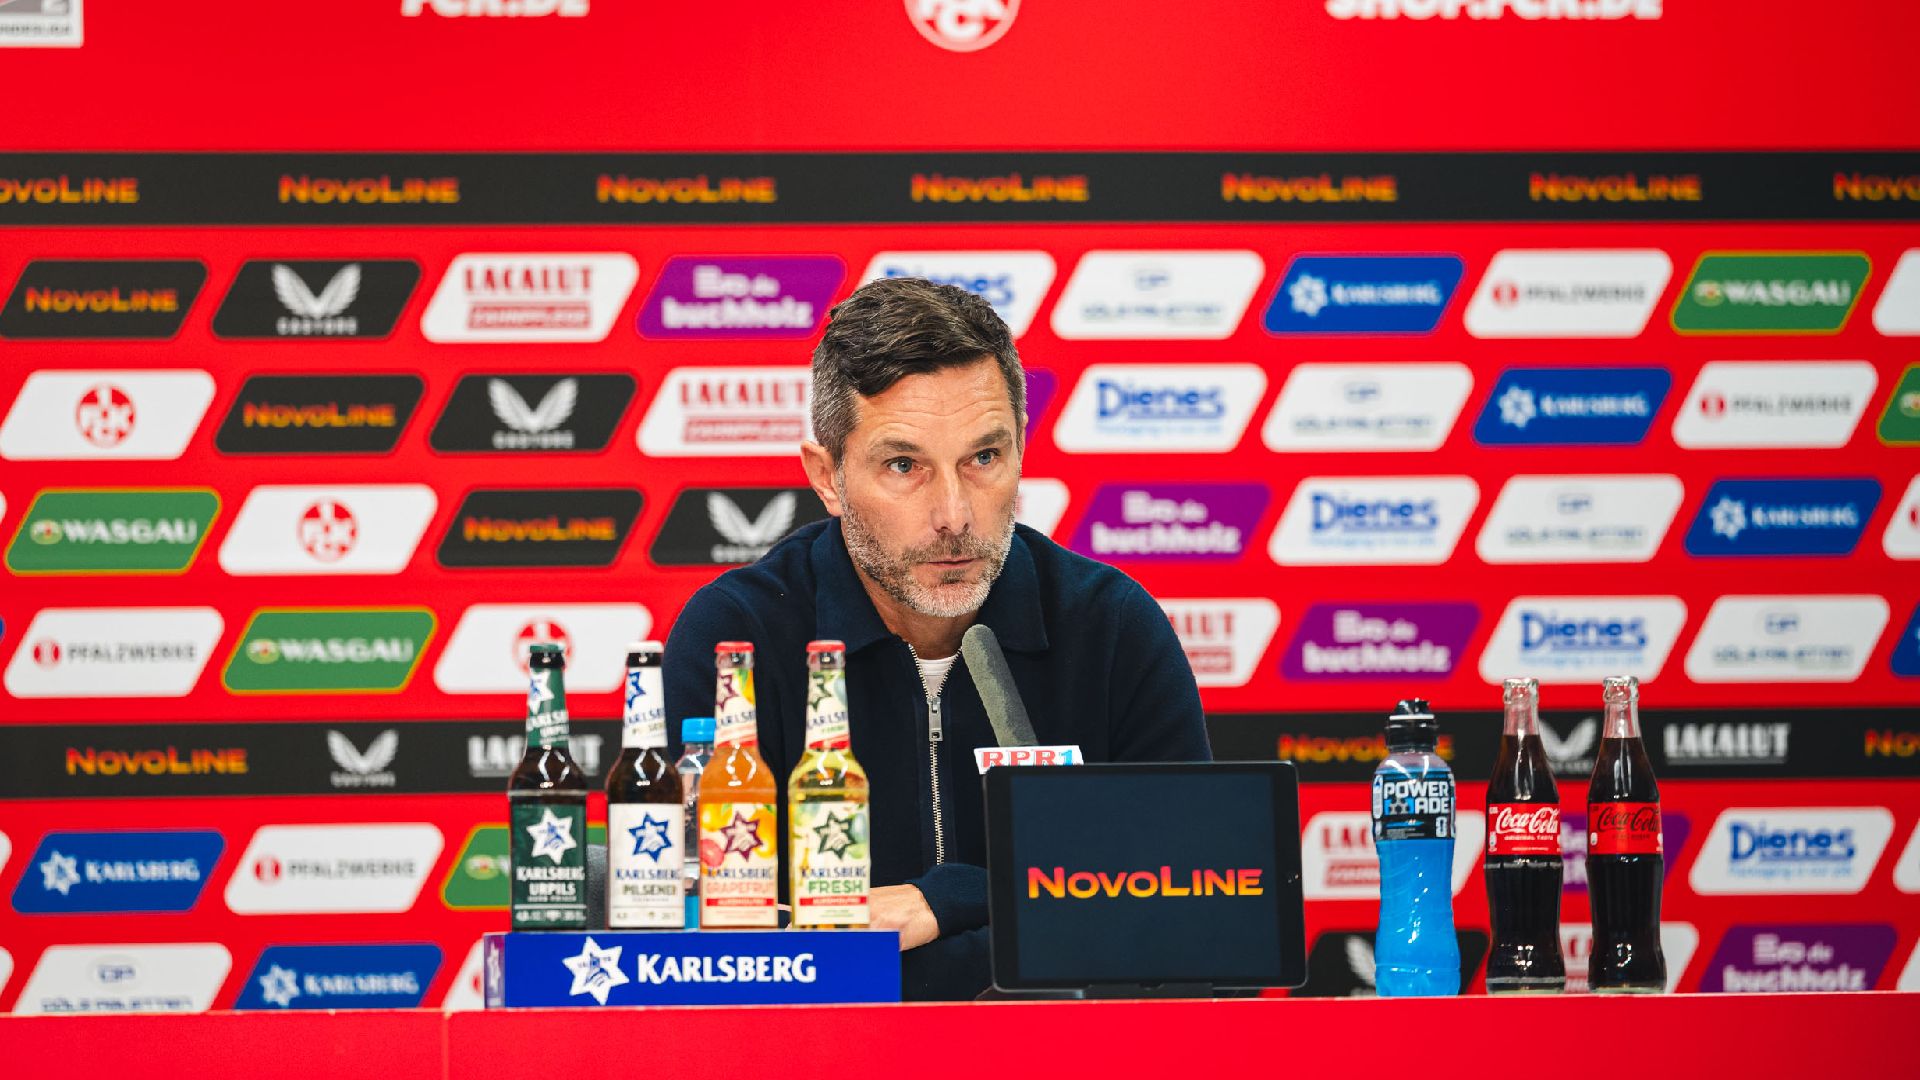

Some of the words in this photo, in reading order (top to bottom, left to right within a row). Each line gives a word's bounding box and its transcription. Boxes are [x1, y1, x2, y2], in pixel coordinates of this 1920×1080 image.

[1725, 281, 1851, 305] WASGAU
[64, 519, 197, 543] WASGAU
[282, 638, 414, 663] WASGAU
[1664, 724, 1791, 758] LACALUT
[1384, 780, 1449, 799] POWER
[1495, 806, 1558, 834] Coca-Cola
[1598, 806, 1660, 833] Coca-Cola
[86, 860, 200, 881] KARLSBERG
[516, 866, 585, 881] KARLSBERG
[616, 869, 681, 880] KARLSBERG
[707, 867, 774, 880] KARLSBERG
[801, 866, 867, 879] KARLSBERG
[529, 883, 576, 896] URPILS
[808, 880, 863, 894] FRESH
[638, 953, 816, 984] KARLSBERG
